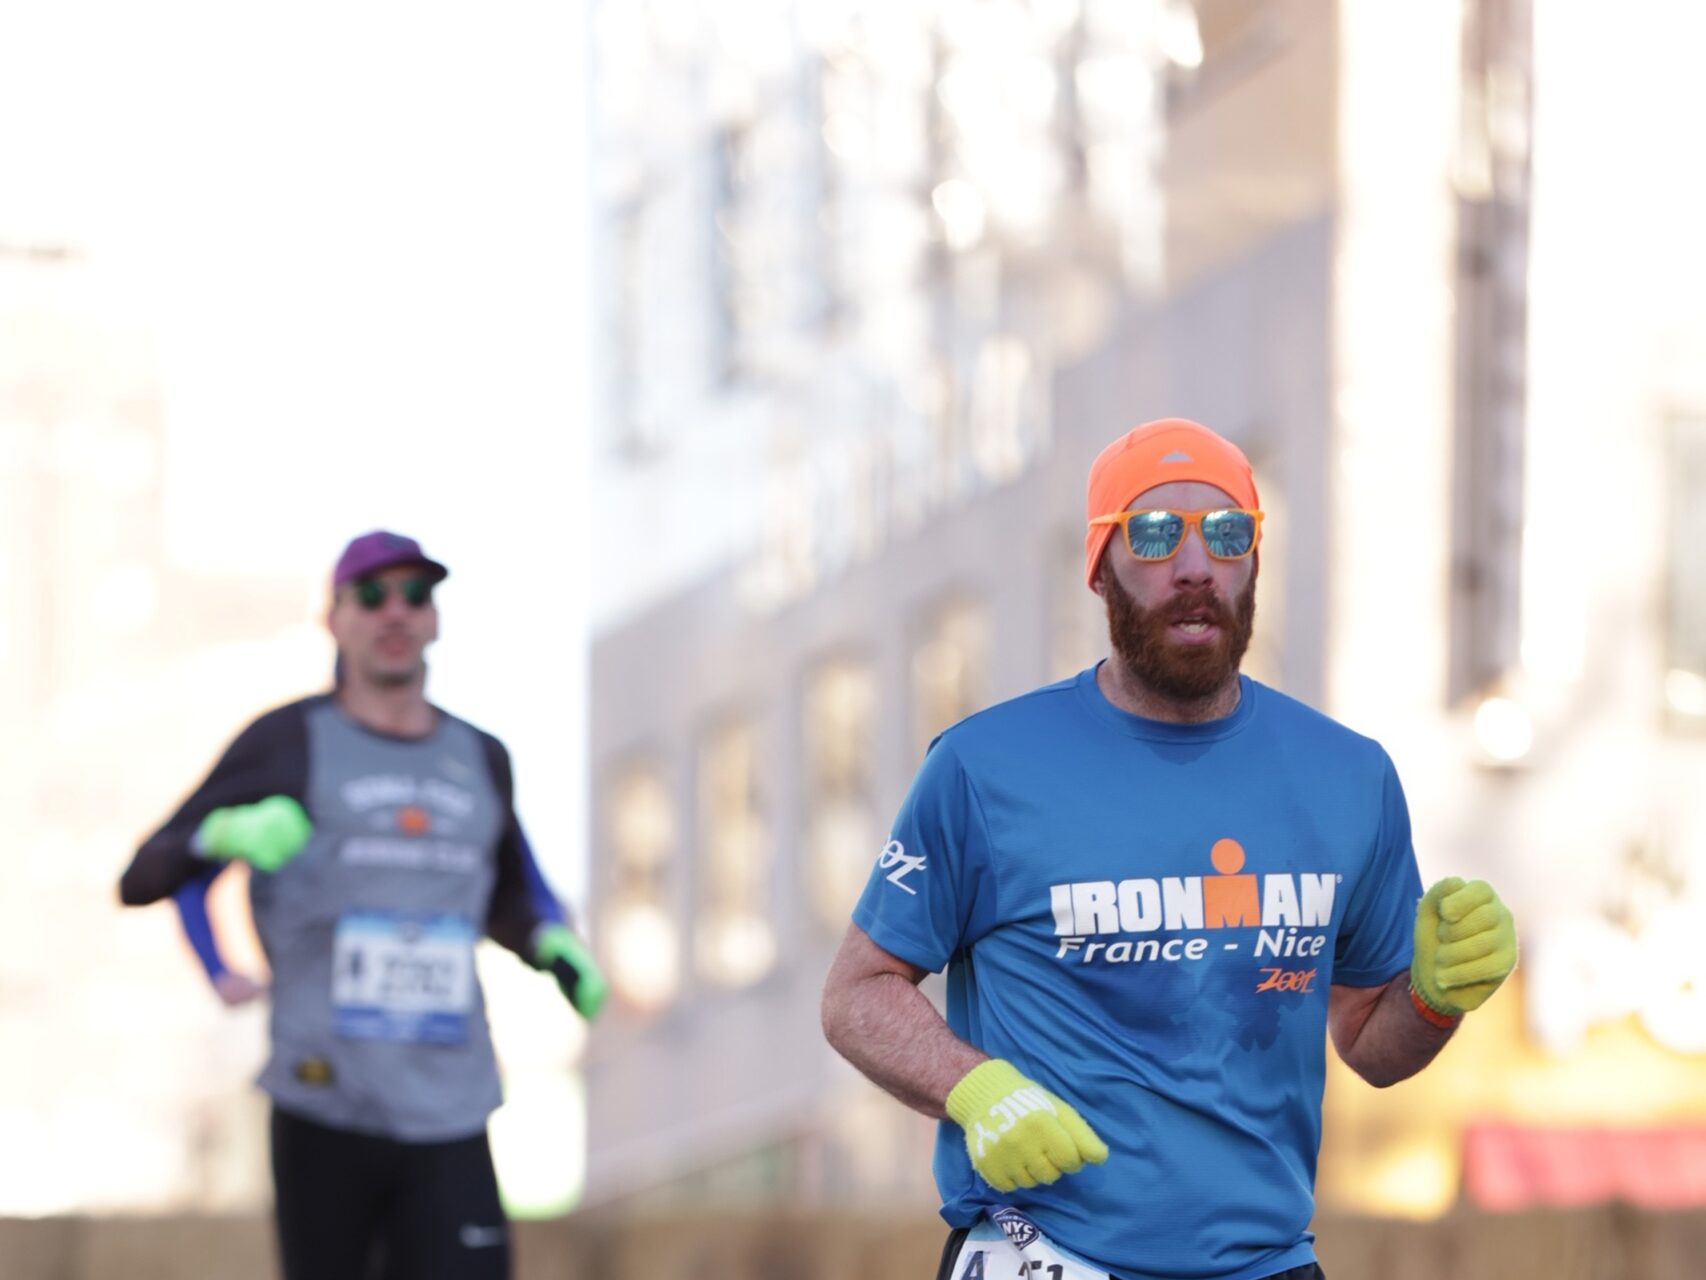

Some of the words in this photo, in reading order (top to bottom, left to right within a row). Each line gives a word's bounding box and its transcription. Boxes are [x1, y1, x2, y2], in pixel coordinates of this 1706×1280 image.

[1050, 872, 1337, 936] IRONMAN
[1055, 936, 1208, 963] France
[1253, 927, 1326, 958] Nice
[1002, 1221, 1033, 1235] NYC
